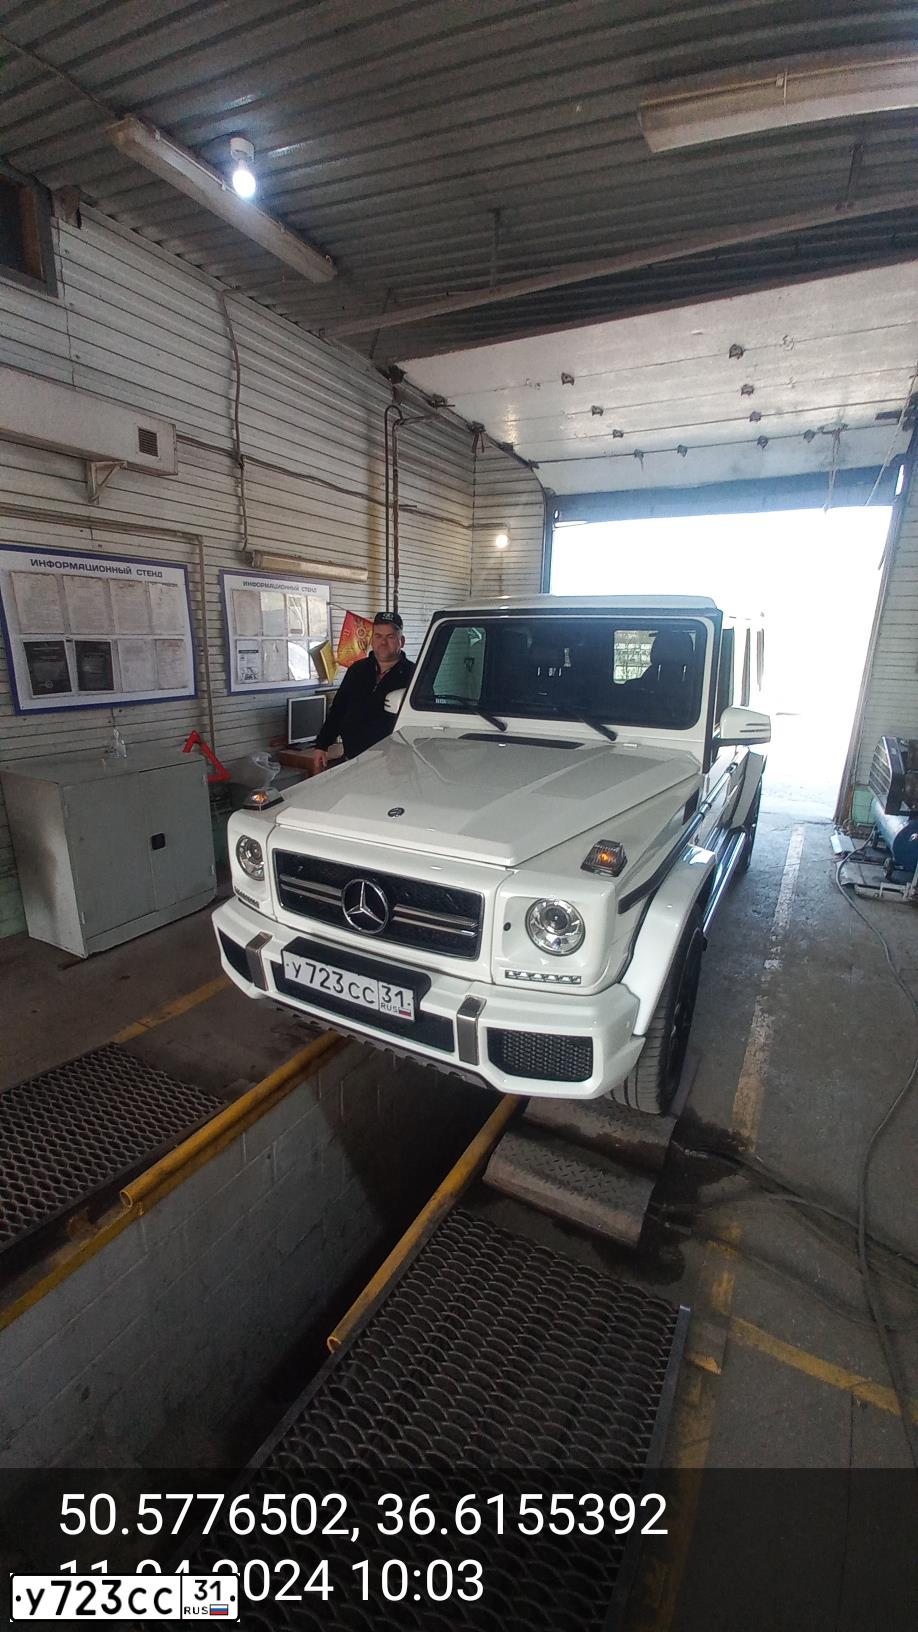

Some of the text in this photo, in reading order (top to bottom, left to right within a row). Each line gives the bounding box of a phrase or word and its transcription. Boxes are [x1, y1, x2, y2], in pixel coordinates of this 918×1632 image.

[30, 559, 163, 578] ИНФОРМАЦИОННЫЙ СТЕНД
[292, 961, 404, 1008] У723СС 31
[380, 1002, 399, 1013] RUS
